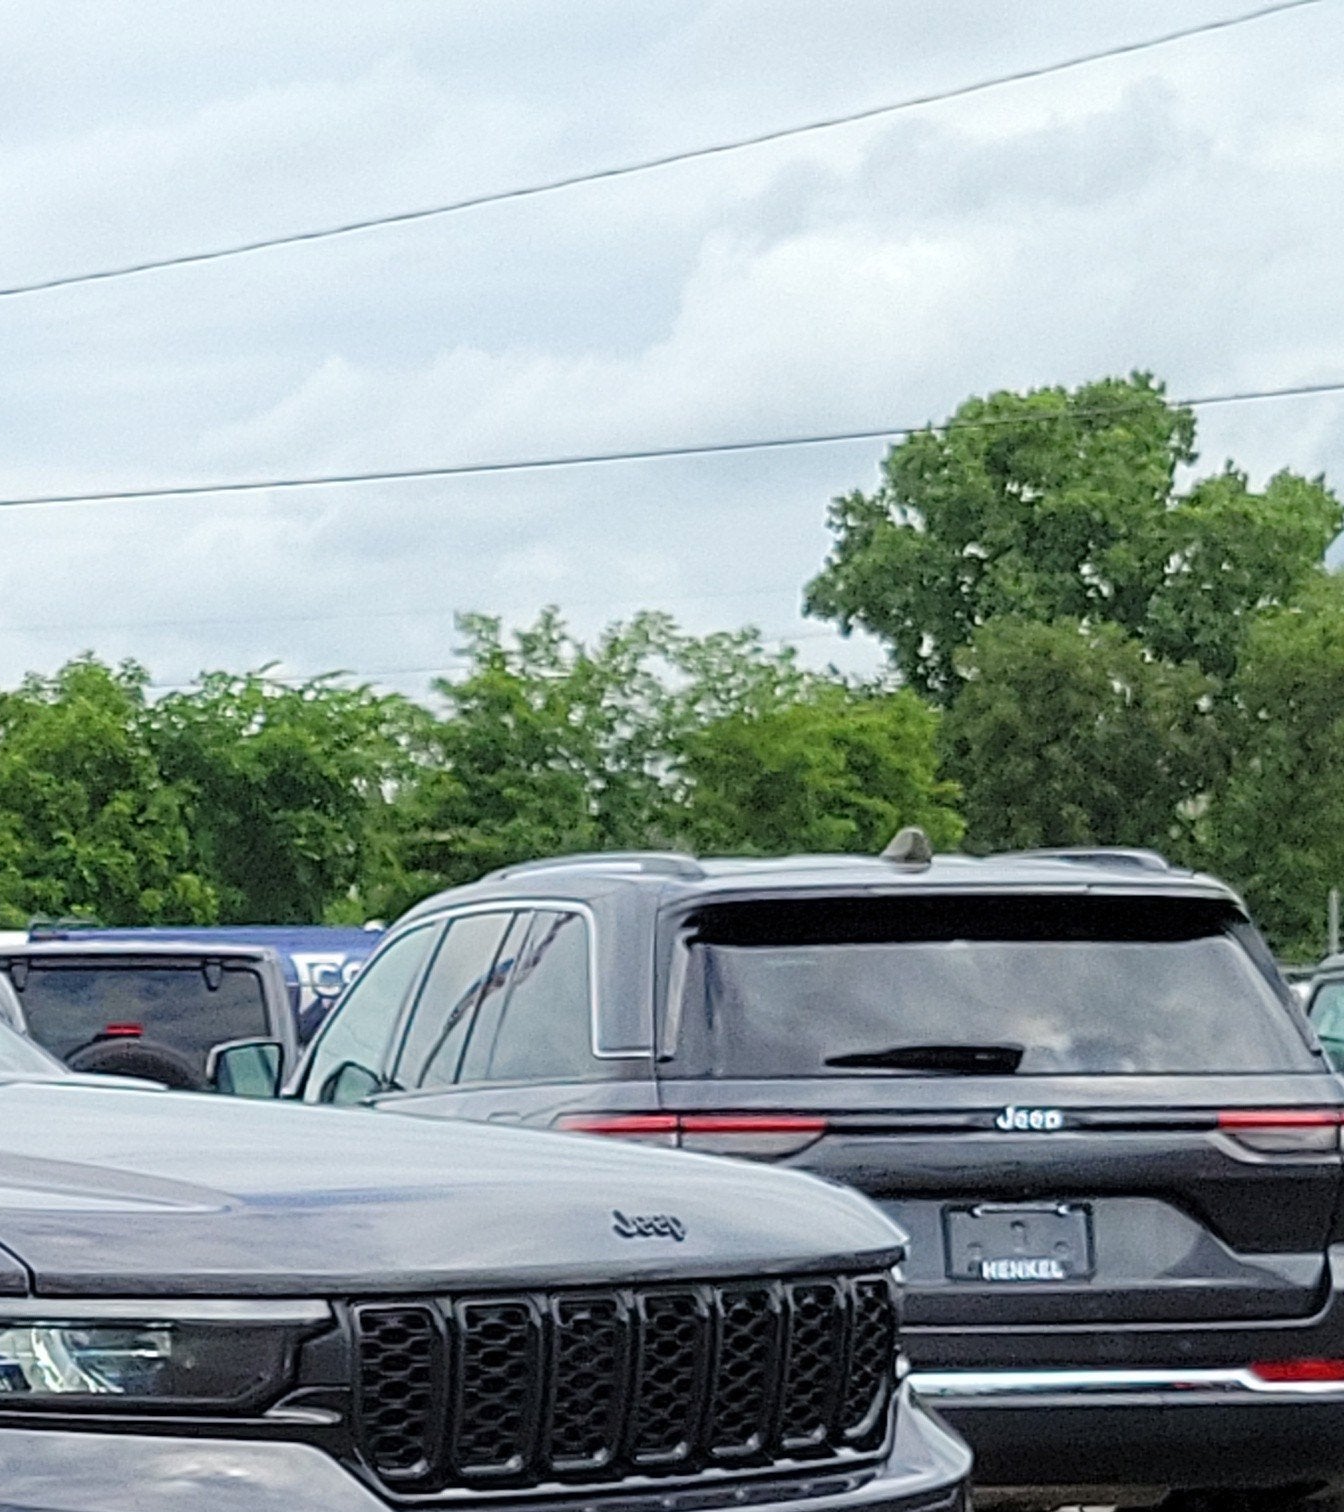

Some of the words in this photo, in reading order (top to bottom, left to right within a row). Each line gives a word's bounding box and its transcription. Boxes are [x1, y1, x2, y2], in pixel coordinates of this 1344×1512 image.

[995, 1105, 1064, 1131] Jeep
[612, 1209, 686, 1242] Jeep
[981, 1258, 1065, 1281] HENKEL
